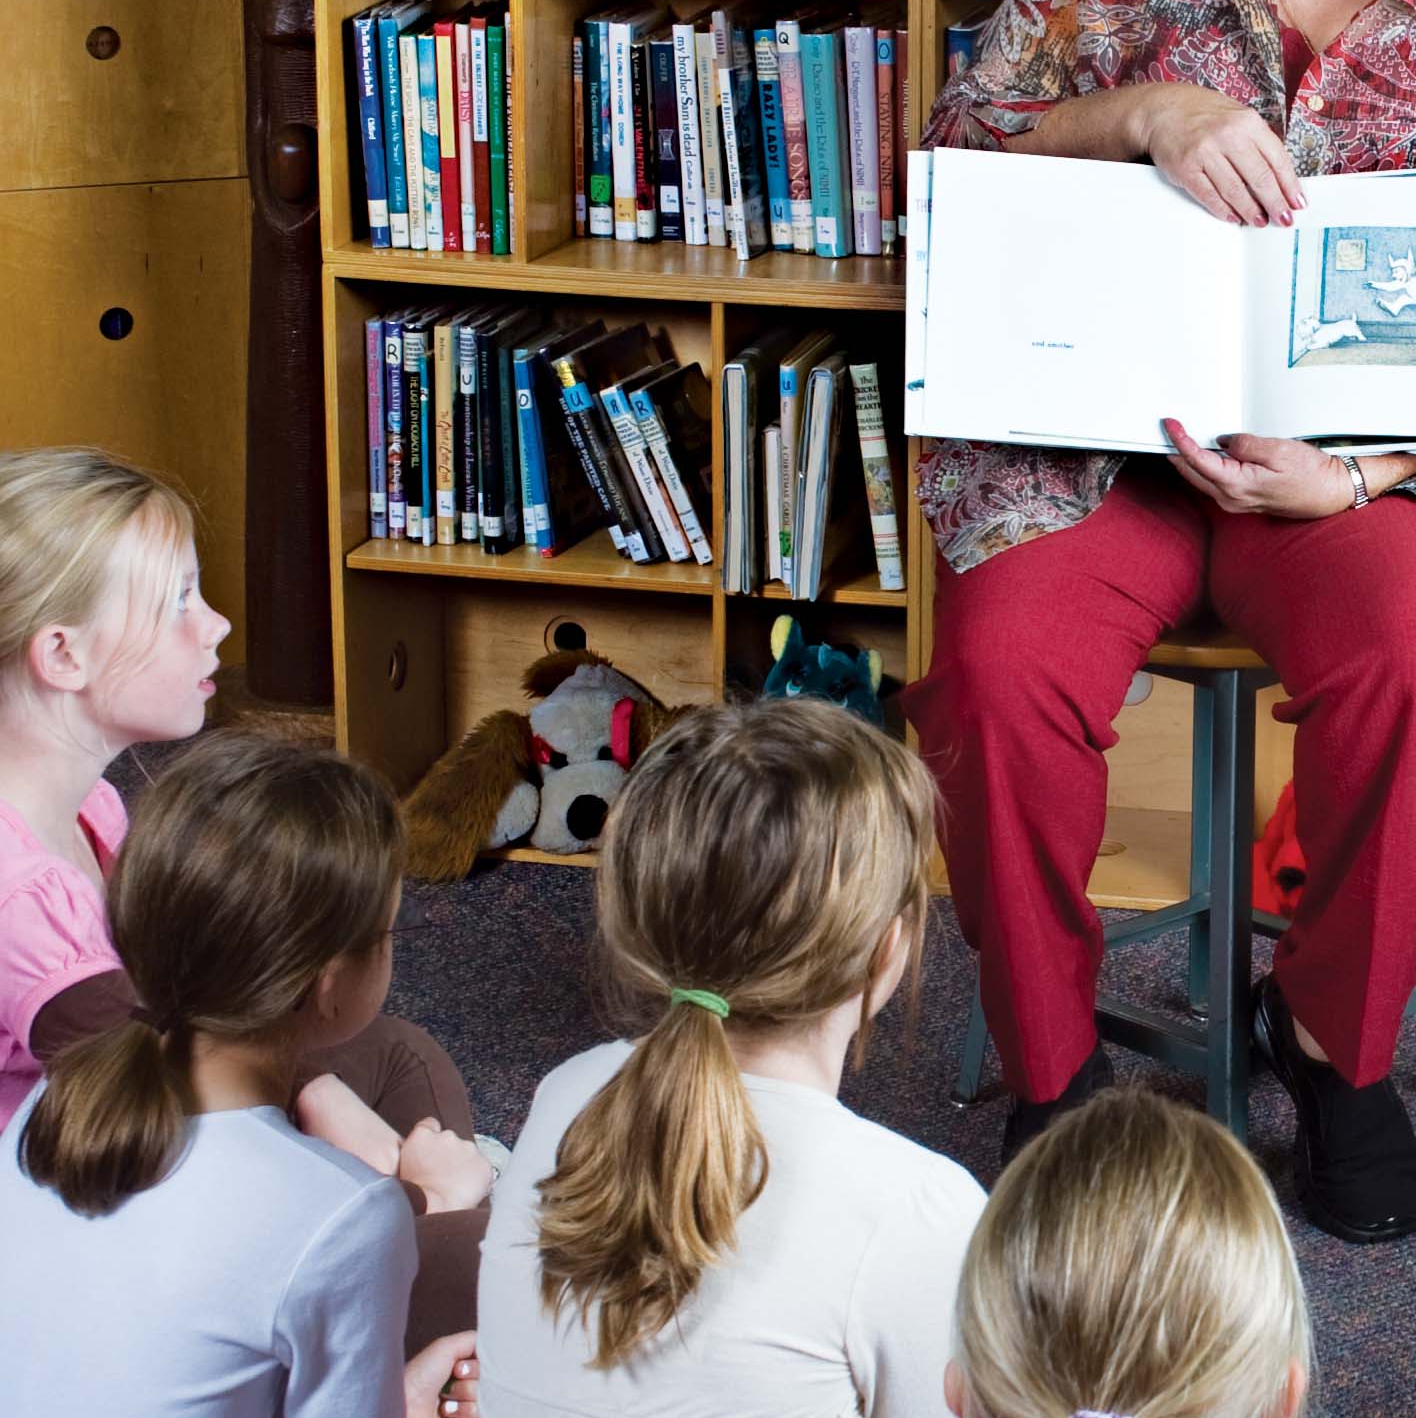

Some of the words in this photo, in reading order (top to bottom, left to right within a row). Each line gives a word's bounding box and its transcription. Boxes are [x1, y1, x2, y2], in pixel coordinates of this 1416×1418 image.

[676, 36, 685, 54] my
[778, 32, 790, 46] Q
[677, 55, 689, 100] brother
[679, 97, 694, 122] Sam
[681, 123, 690, 132] is
[879, 93, 893, 152] STAYING
[683, 134, 697, 157] dead
[768, 127, 781, 169] LADY!
[791, 143, 811, 199] SONGS
[881, 154, 893, 190] NINE
[387, 344, 398, 360] R
[410, 376, 418, 388] THE
[859, 375, 873, 385] The
[410, 389, 419, 409] LIGHT
[570, 392, 584, 406] U
[634, 401, 648, 416] R
[410, 410, 419, 420] ON
[410, 421, 420, 453] HOGBACK
[411, 454, 420, 468] HILL
[558, 398, 569, 416] BOY
[567, 417, 575, 428] OF
[573, 429, 583, 448] THE
[580, 449, 600, 486] PAINTED
[597, 486, 610, 512] CAVE
[466, 457, 475, 485] Lucas
